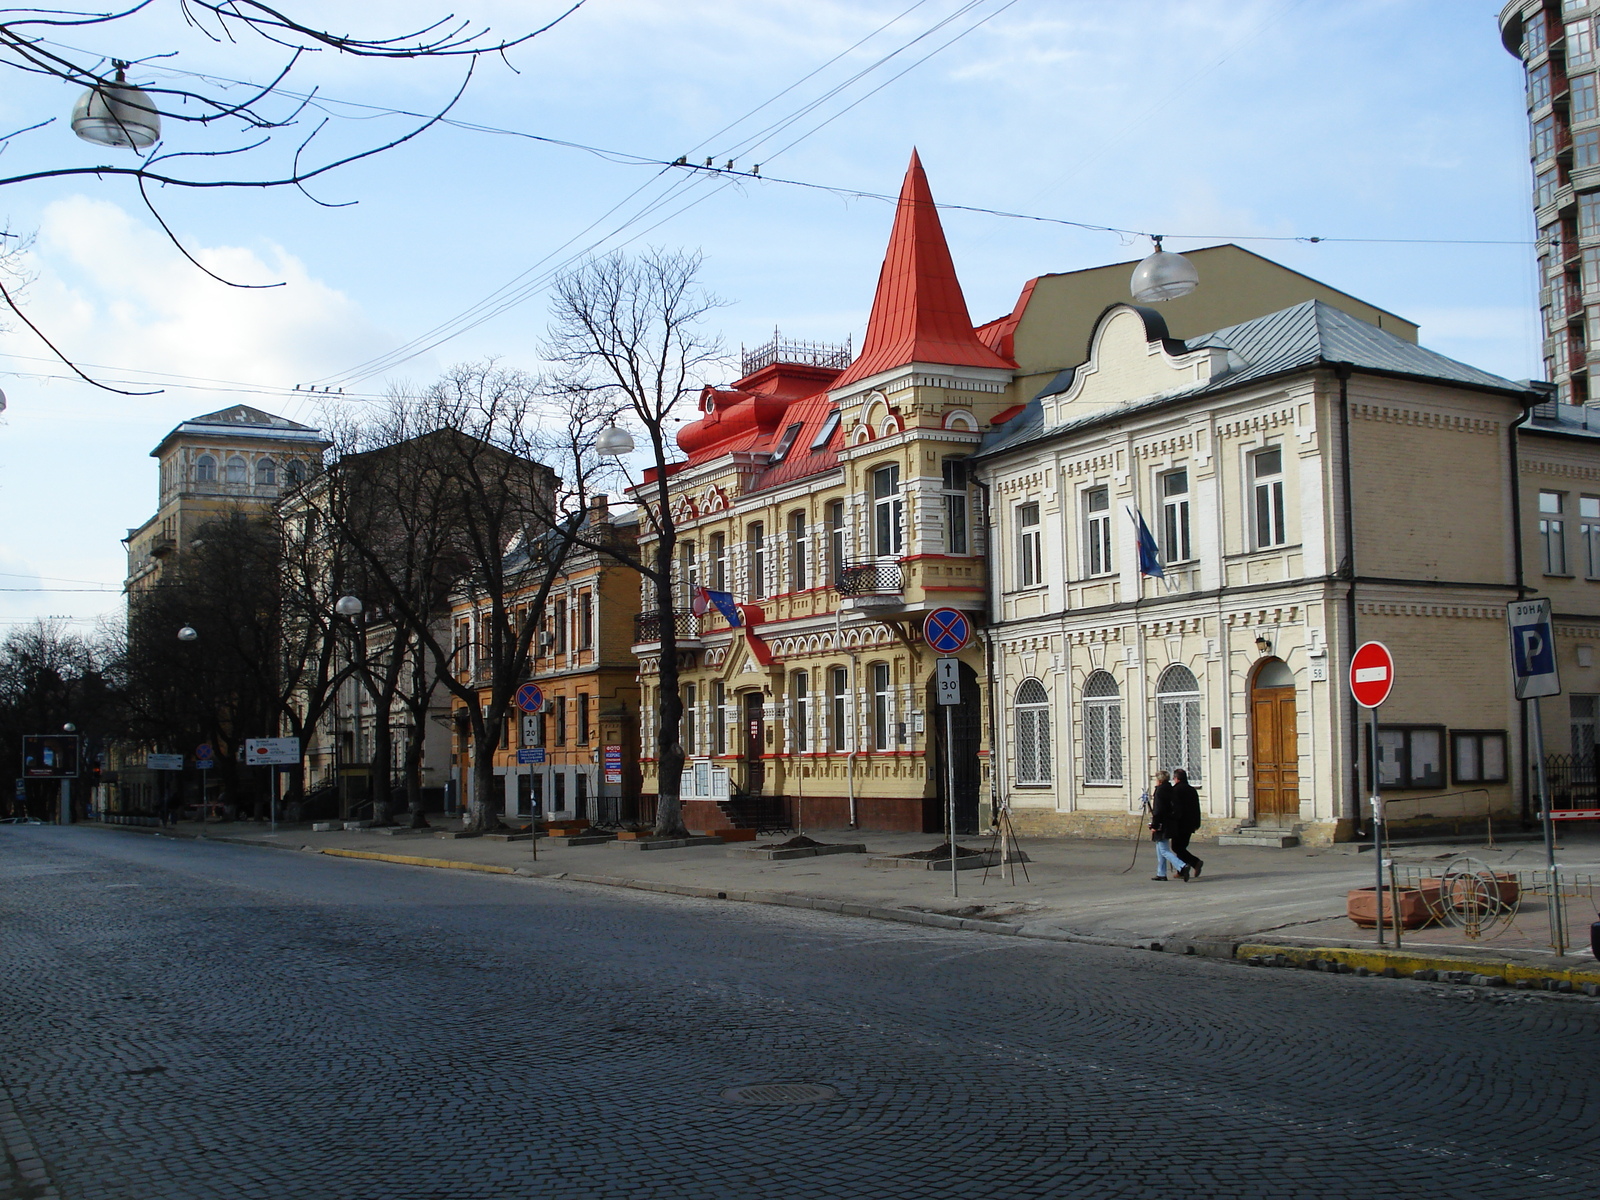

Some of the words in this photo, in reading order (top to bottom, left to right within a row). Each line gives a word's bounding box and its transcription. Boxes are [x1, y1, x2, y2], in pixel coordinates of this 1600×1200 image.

[1516, 604, 1543, 616] ЗОНА
[1313, 668, 1323, 678] 58
[941, 680, 957, 691] 30
